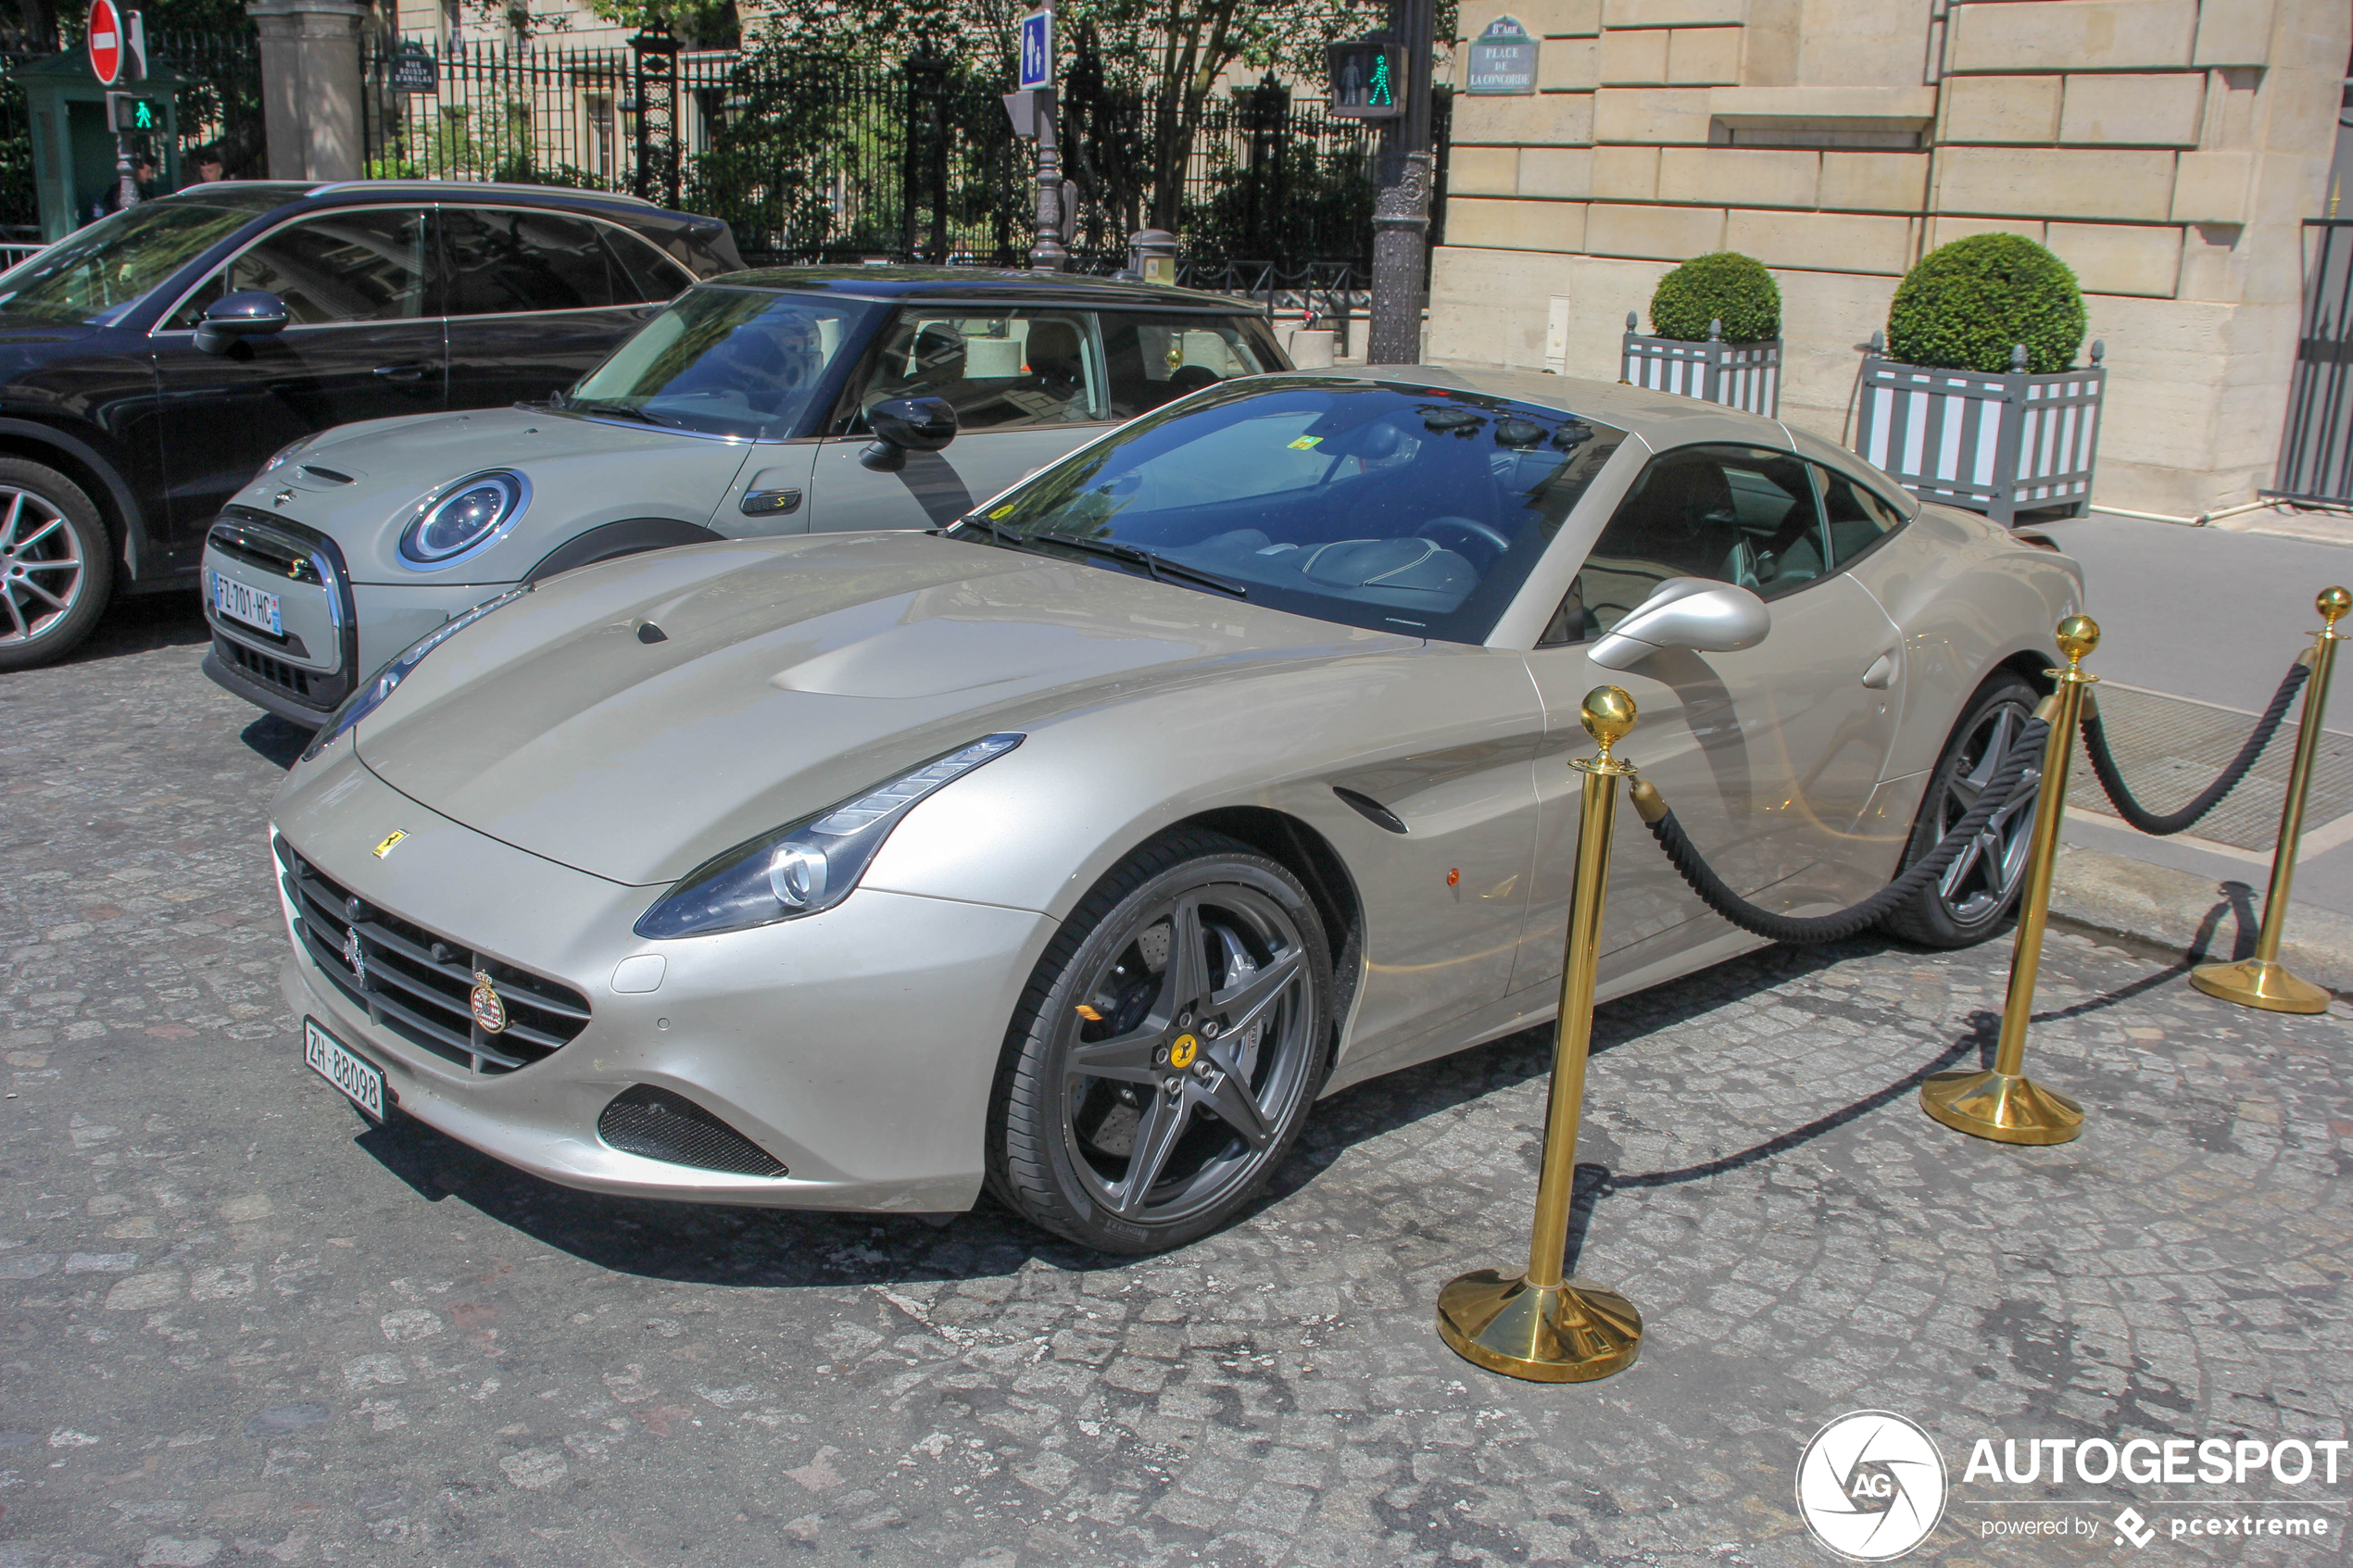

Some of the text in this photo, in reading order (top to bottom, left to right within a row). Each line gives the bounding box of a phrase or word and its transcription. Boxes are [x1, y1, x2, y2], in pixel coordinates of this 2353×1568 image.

[1485, 47, 1519, 59] PLACE
[405, 60, 422, 69] RUE
[1494, 61, 1508, 71] DE
[399, 67, 428, 75] BOISSY
[395, 74, 434, 83] D'ANGLAS
[1470, 73, 1530, 85] LA CONCORDE
